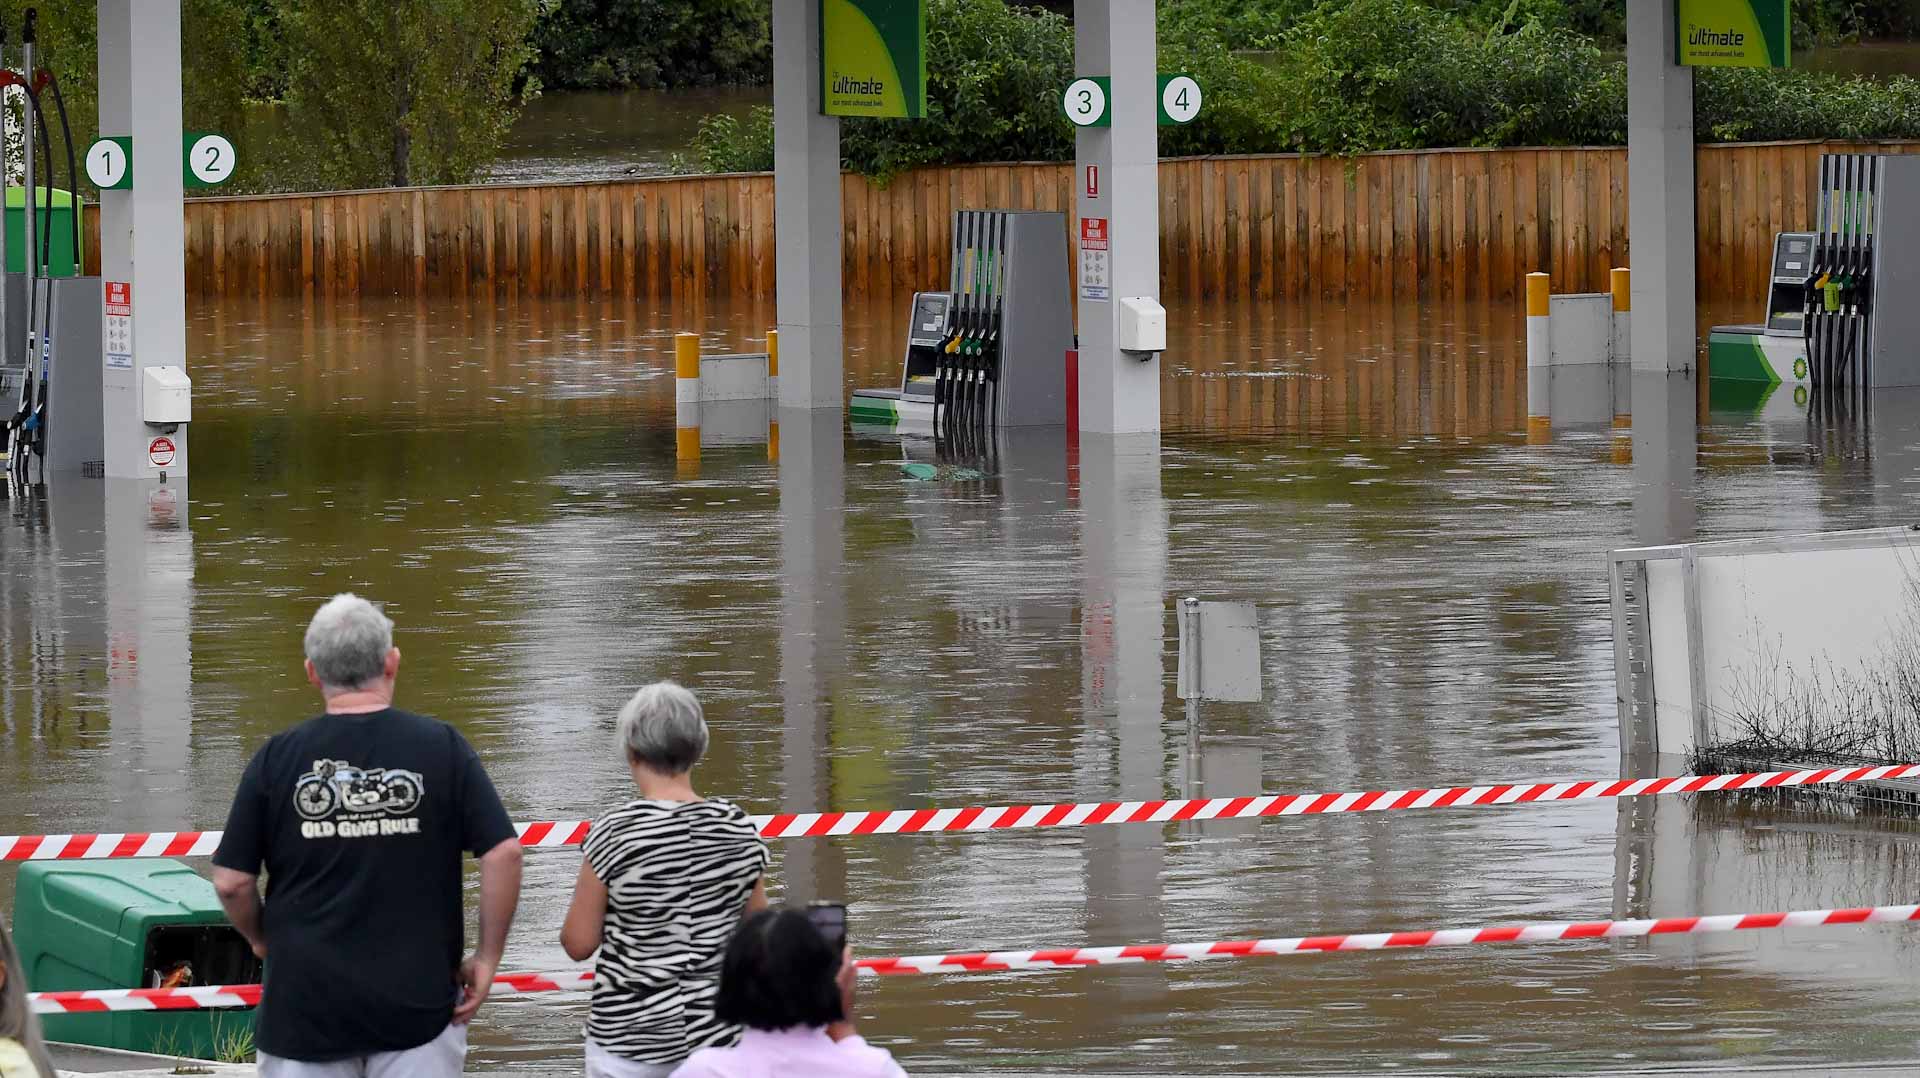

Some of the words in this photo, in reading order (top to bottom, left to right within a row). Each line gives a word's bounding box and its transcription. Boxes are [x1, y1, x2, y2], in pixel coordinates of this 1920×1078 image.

[1689, 27, 1744, 45] ultimate
[832, 76, 883, 94] ultimate
[1077, 90, 1092, 114] 3
[1174, 87, 1190, 111] 4
[102, 151, 111, 175] 1
[204, 147, 220, 172] 2
[301, 821, 335, 838] OLD
[337, 820, 378, 837] GUYS
[379, 818, 419, 835] RULE
